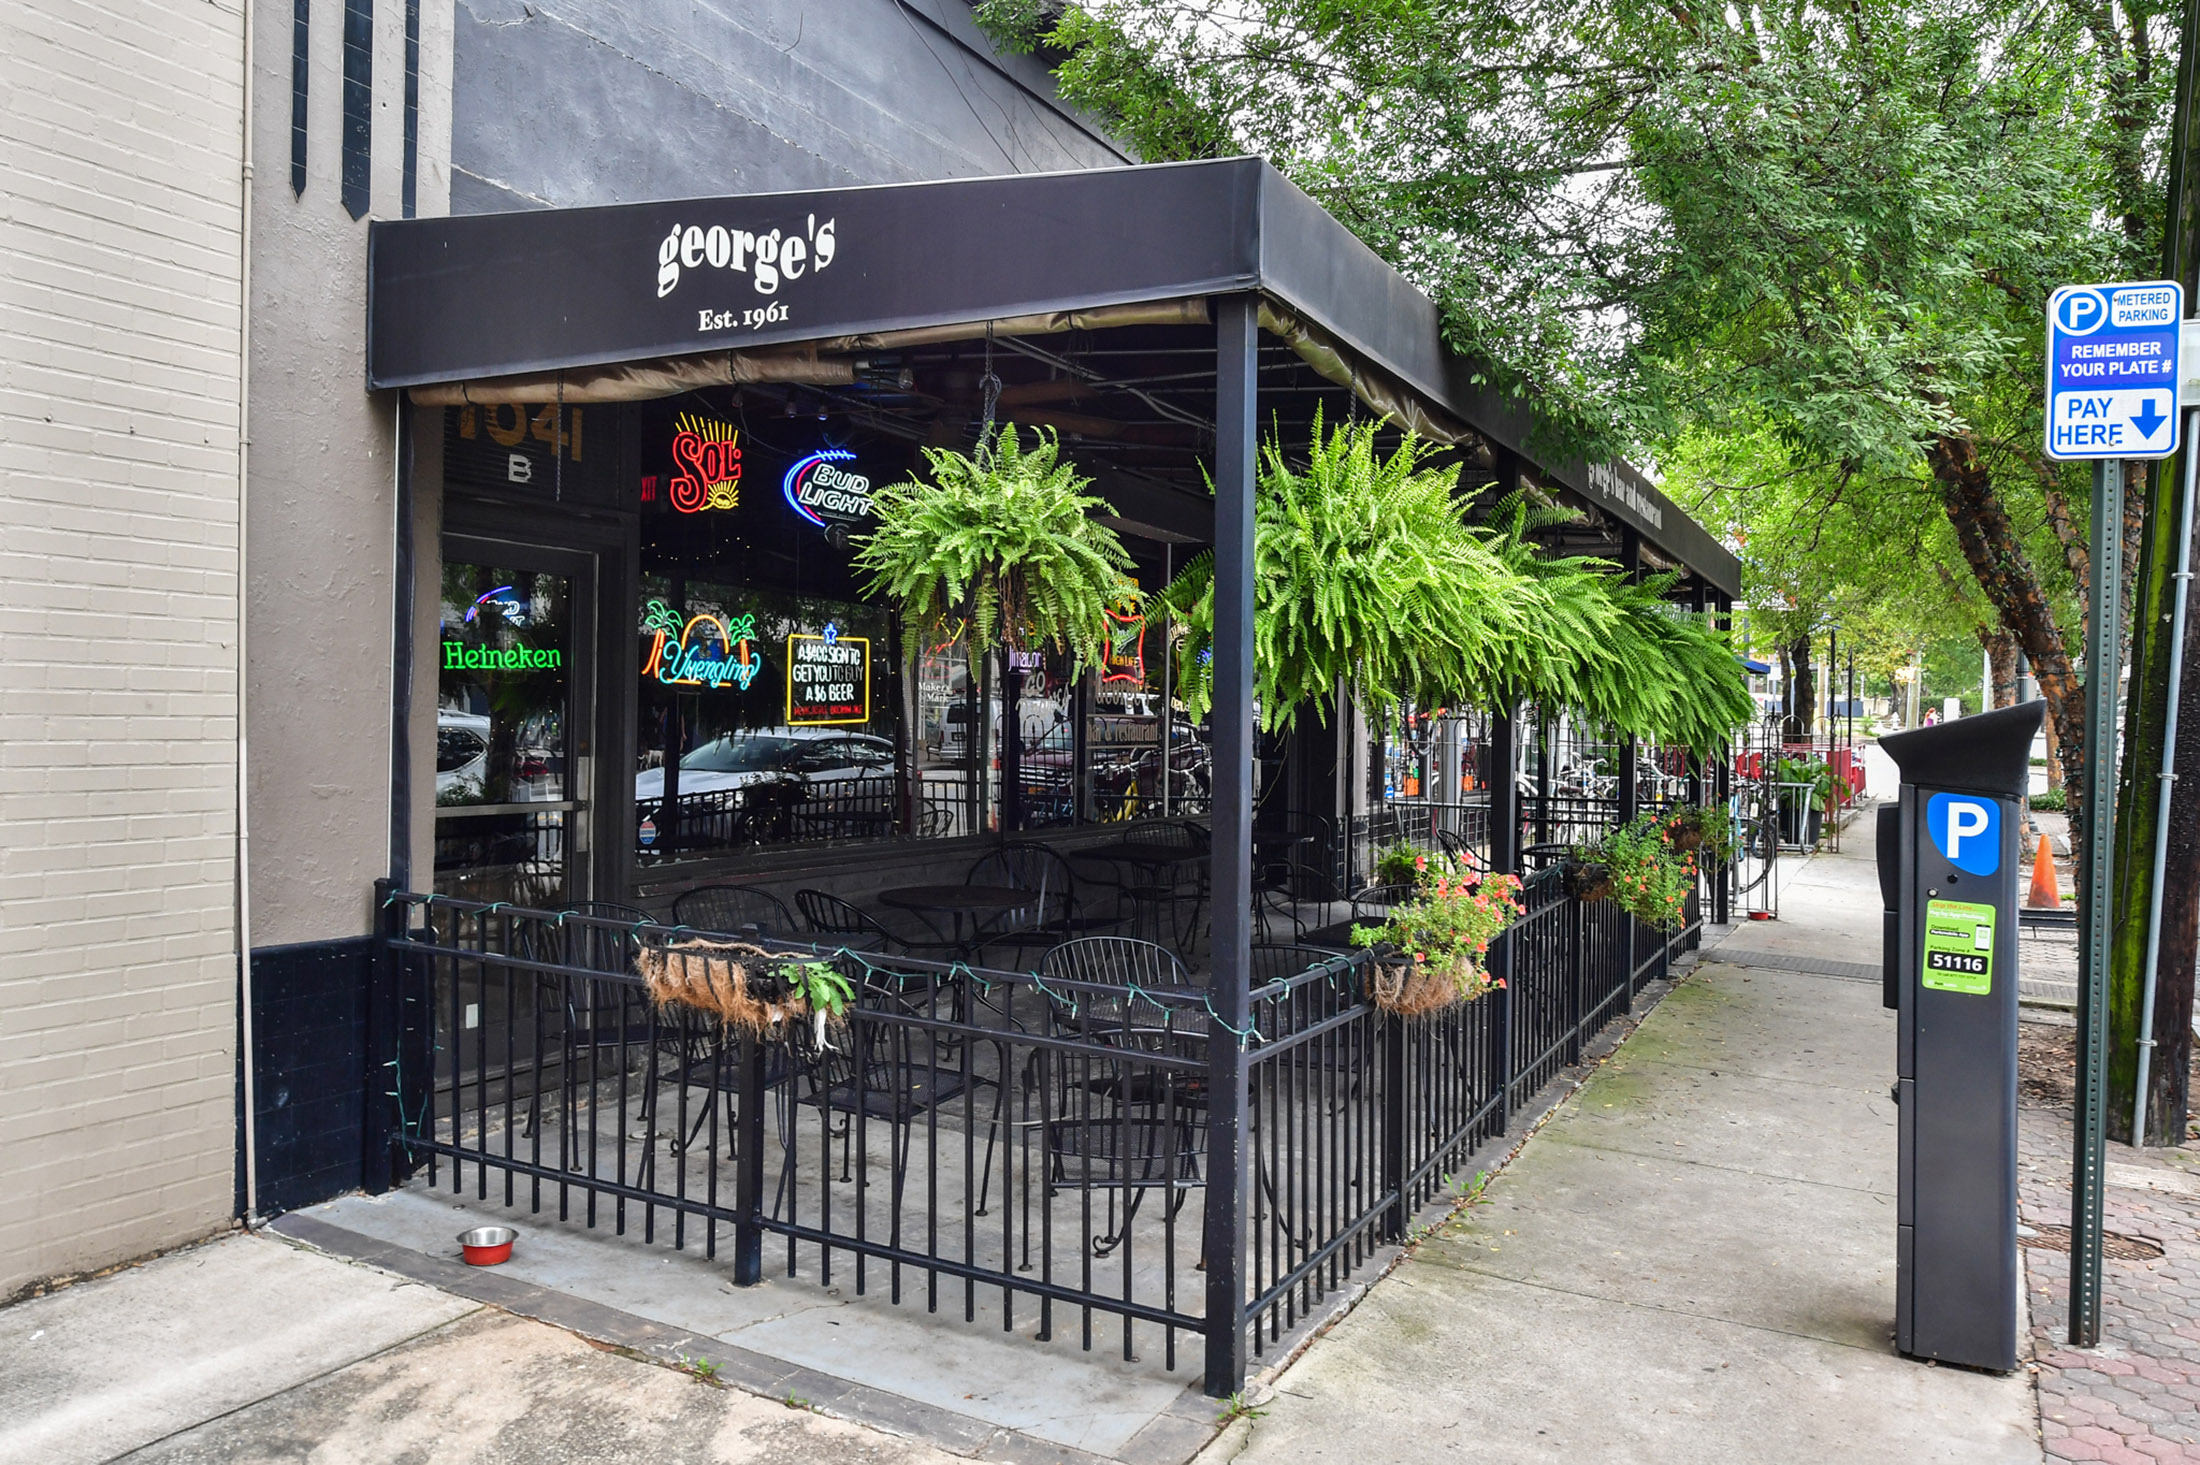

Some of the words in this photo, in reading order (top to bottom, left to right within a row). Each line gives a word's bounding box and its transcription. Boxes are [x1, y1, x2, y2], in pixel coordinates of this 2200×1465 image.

[657, 213, 837, 298] george's
[2116, 292, 2171, 307] METERED
[698, 308, 738, 331] Est.
[743, 302, 789, 329] 1961
[2118, 308, 2169, 322] PARKING
[2071, 342, 2162, 359] REMEMBER
[2061, 363, 2105, 377] YOUR
[2108, 360, 2159, 375] PLATE
[2162, 360, 2173, 373] #
[2068, 397, 2113, 419] PAY
[2057, 424, 2123, 446] HERE
[508, 453, 532, 483] B
[812, 463, 870, 494] BUD
[641, 476, 658, 502] XIT
[798, 482, 874, 516] LIGHT
[442, 641, 562, 670] Heineken
[659, 640, 762, 691] Yuengling
[792, 664, 812, 682] GET
[805, 685, 813, 702] A
[828, 683, 854, 702] BEER
[1087, 721, 1101, 742] bar
[1115, 722, 1158, 742] restaurant
[1946, 802, 1989, 859] P
[1932, 954, 1983, 971] 51116
